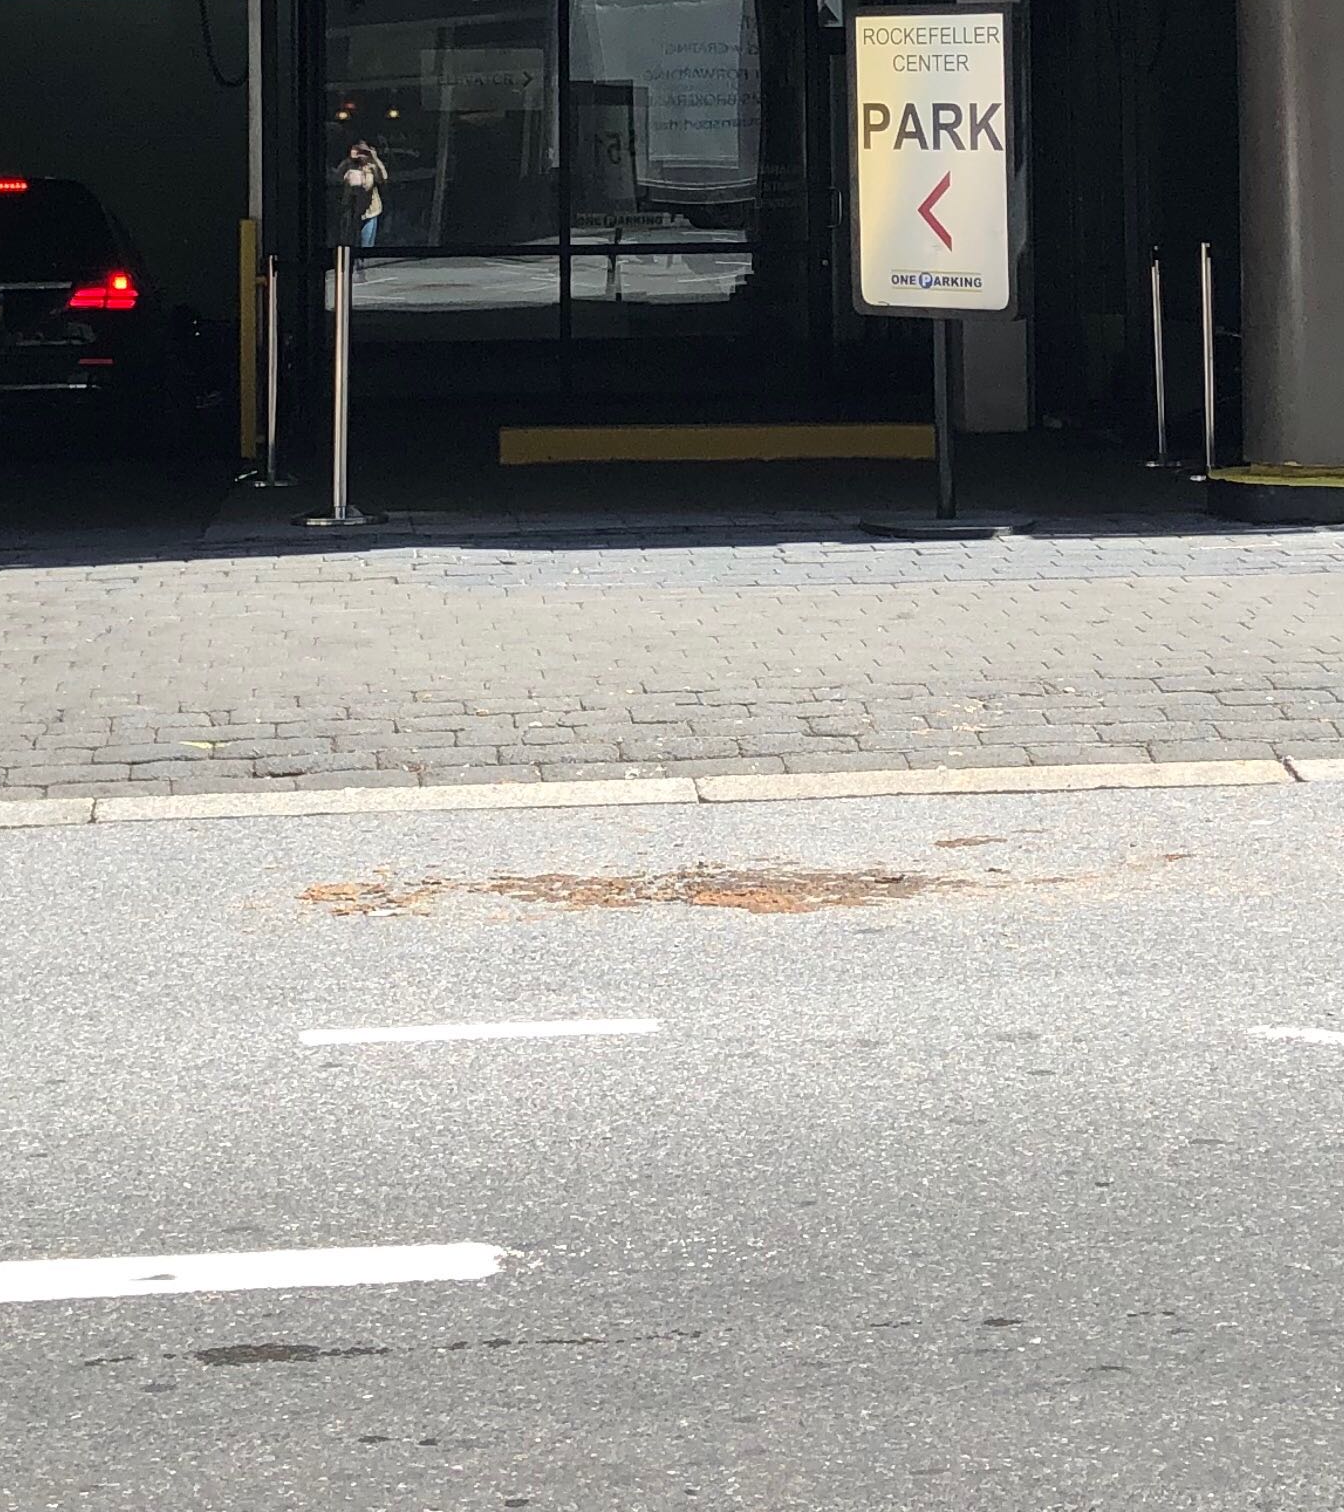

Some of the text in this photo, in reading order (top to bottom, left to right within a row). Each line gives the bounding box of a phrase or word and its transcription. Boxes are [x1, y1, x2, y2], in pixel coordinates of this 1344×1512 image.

[862, 26, 1001, 46] ROCKEFELLER
[892, 54, 970, 73] CENTER
[862, 102, 1004, 151] PARK
[891, 271, 983, 289] ONE PARKING
